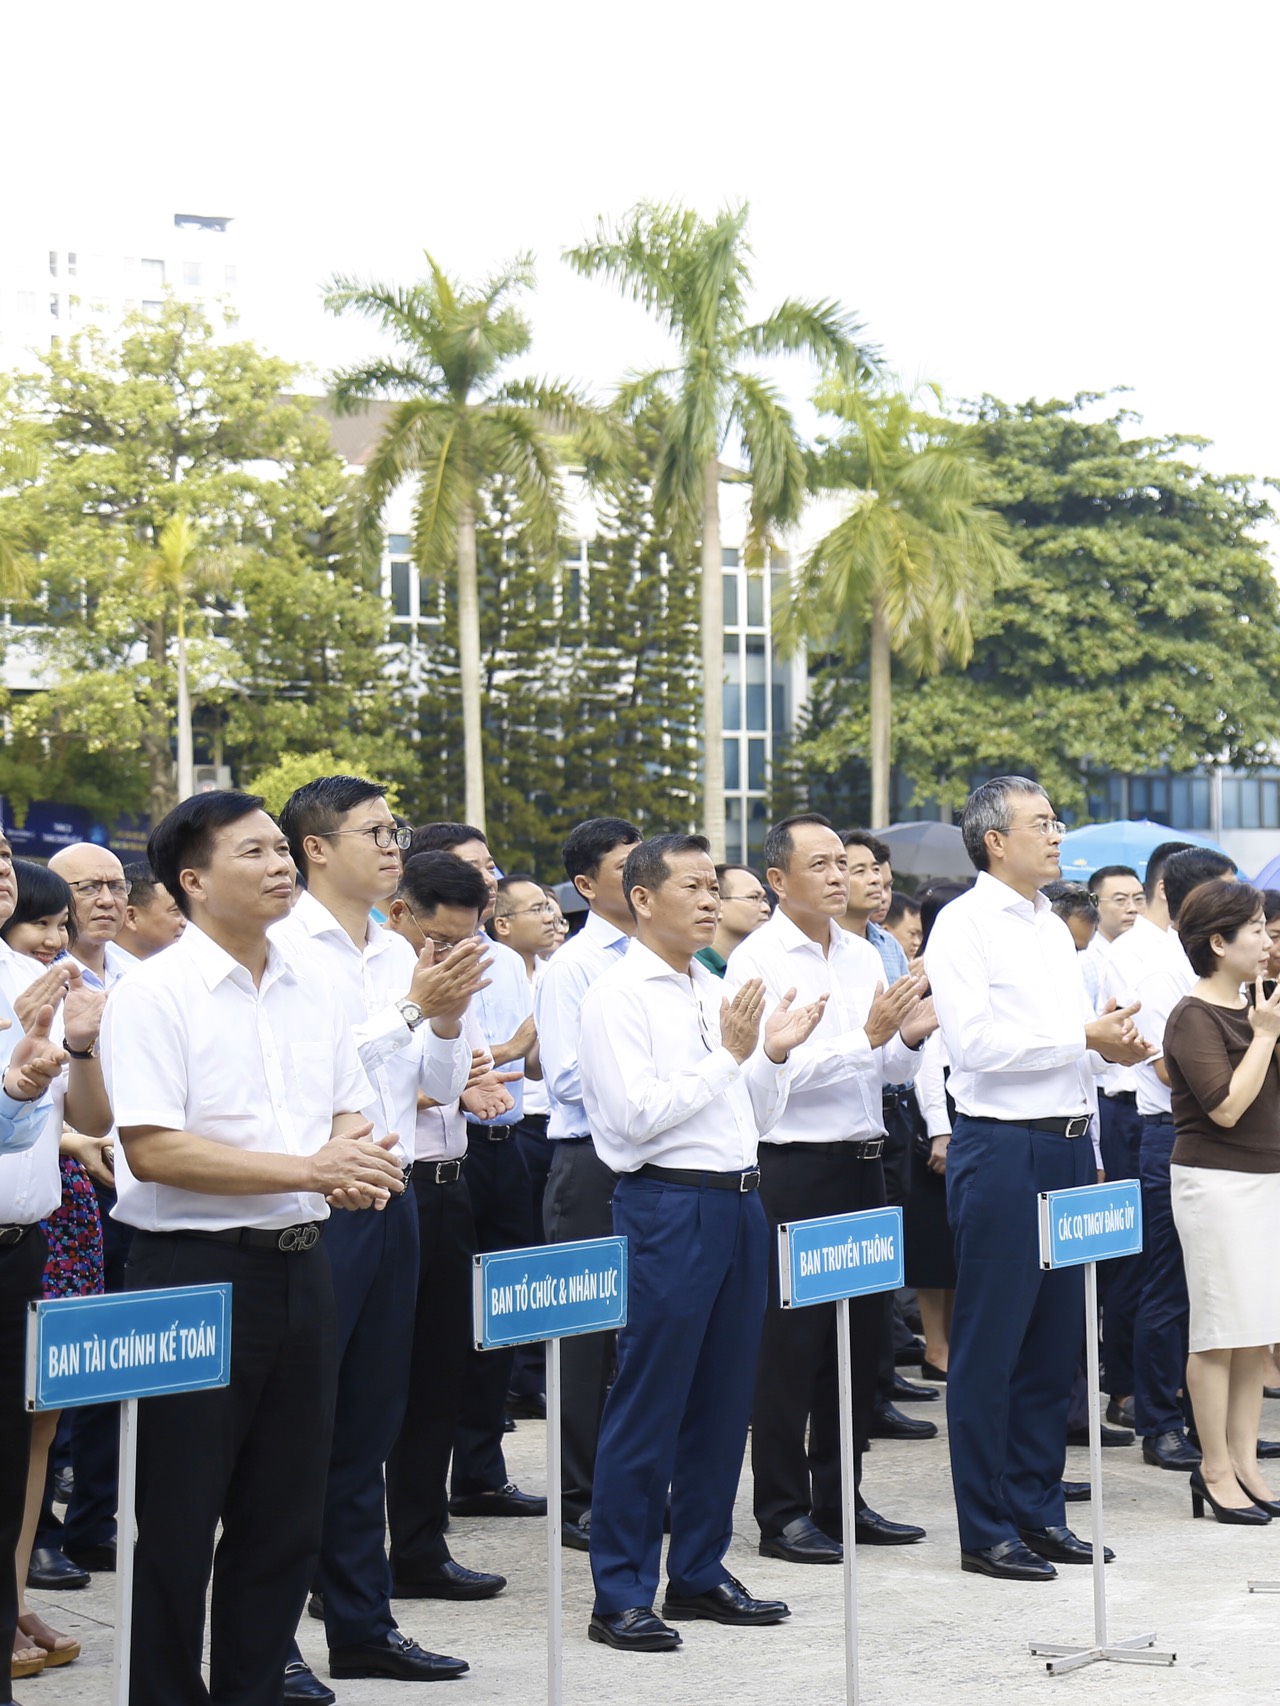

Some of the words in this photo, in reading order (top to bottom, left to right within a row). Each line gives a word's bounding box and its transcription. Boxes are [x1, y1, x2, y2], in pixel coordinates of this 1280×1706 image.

[1058, 1212, 1072, 1241] CÁC
[1073, 1215, 1083, 1240] CQ
[1083, 1211, 1104, 1237] TMGV
[1104, 1203, 1124, 1233] ĐẢNG
[1125, 1200, 1135, 1230] ỦY
[800, 1248, 821, 1277] BAN
[822, 1235, 860, 1273] TRUYỀN
[861, 1233, 894, 1266] THÔNG
[491, 1285, 513, 1316] BAN
[515, 1273, 528, 1312] TỔ
[530, 1274, 557, 1310] CHỨC
[559, 1277, 567, 1305] &
[569, 1268, 597, 1303] NHÂN
[599, 1266, 618, 1305] LỰC
[48, 1342, 80, 1379] BAN
[83, 1333, 106, 1373] TÀI
[110, 1329, 155, 1370] CHÍNH
[159, 1320, 178, 1363] KẾ
[179, 1320, 216, 1360] TOÁN
